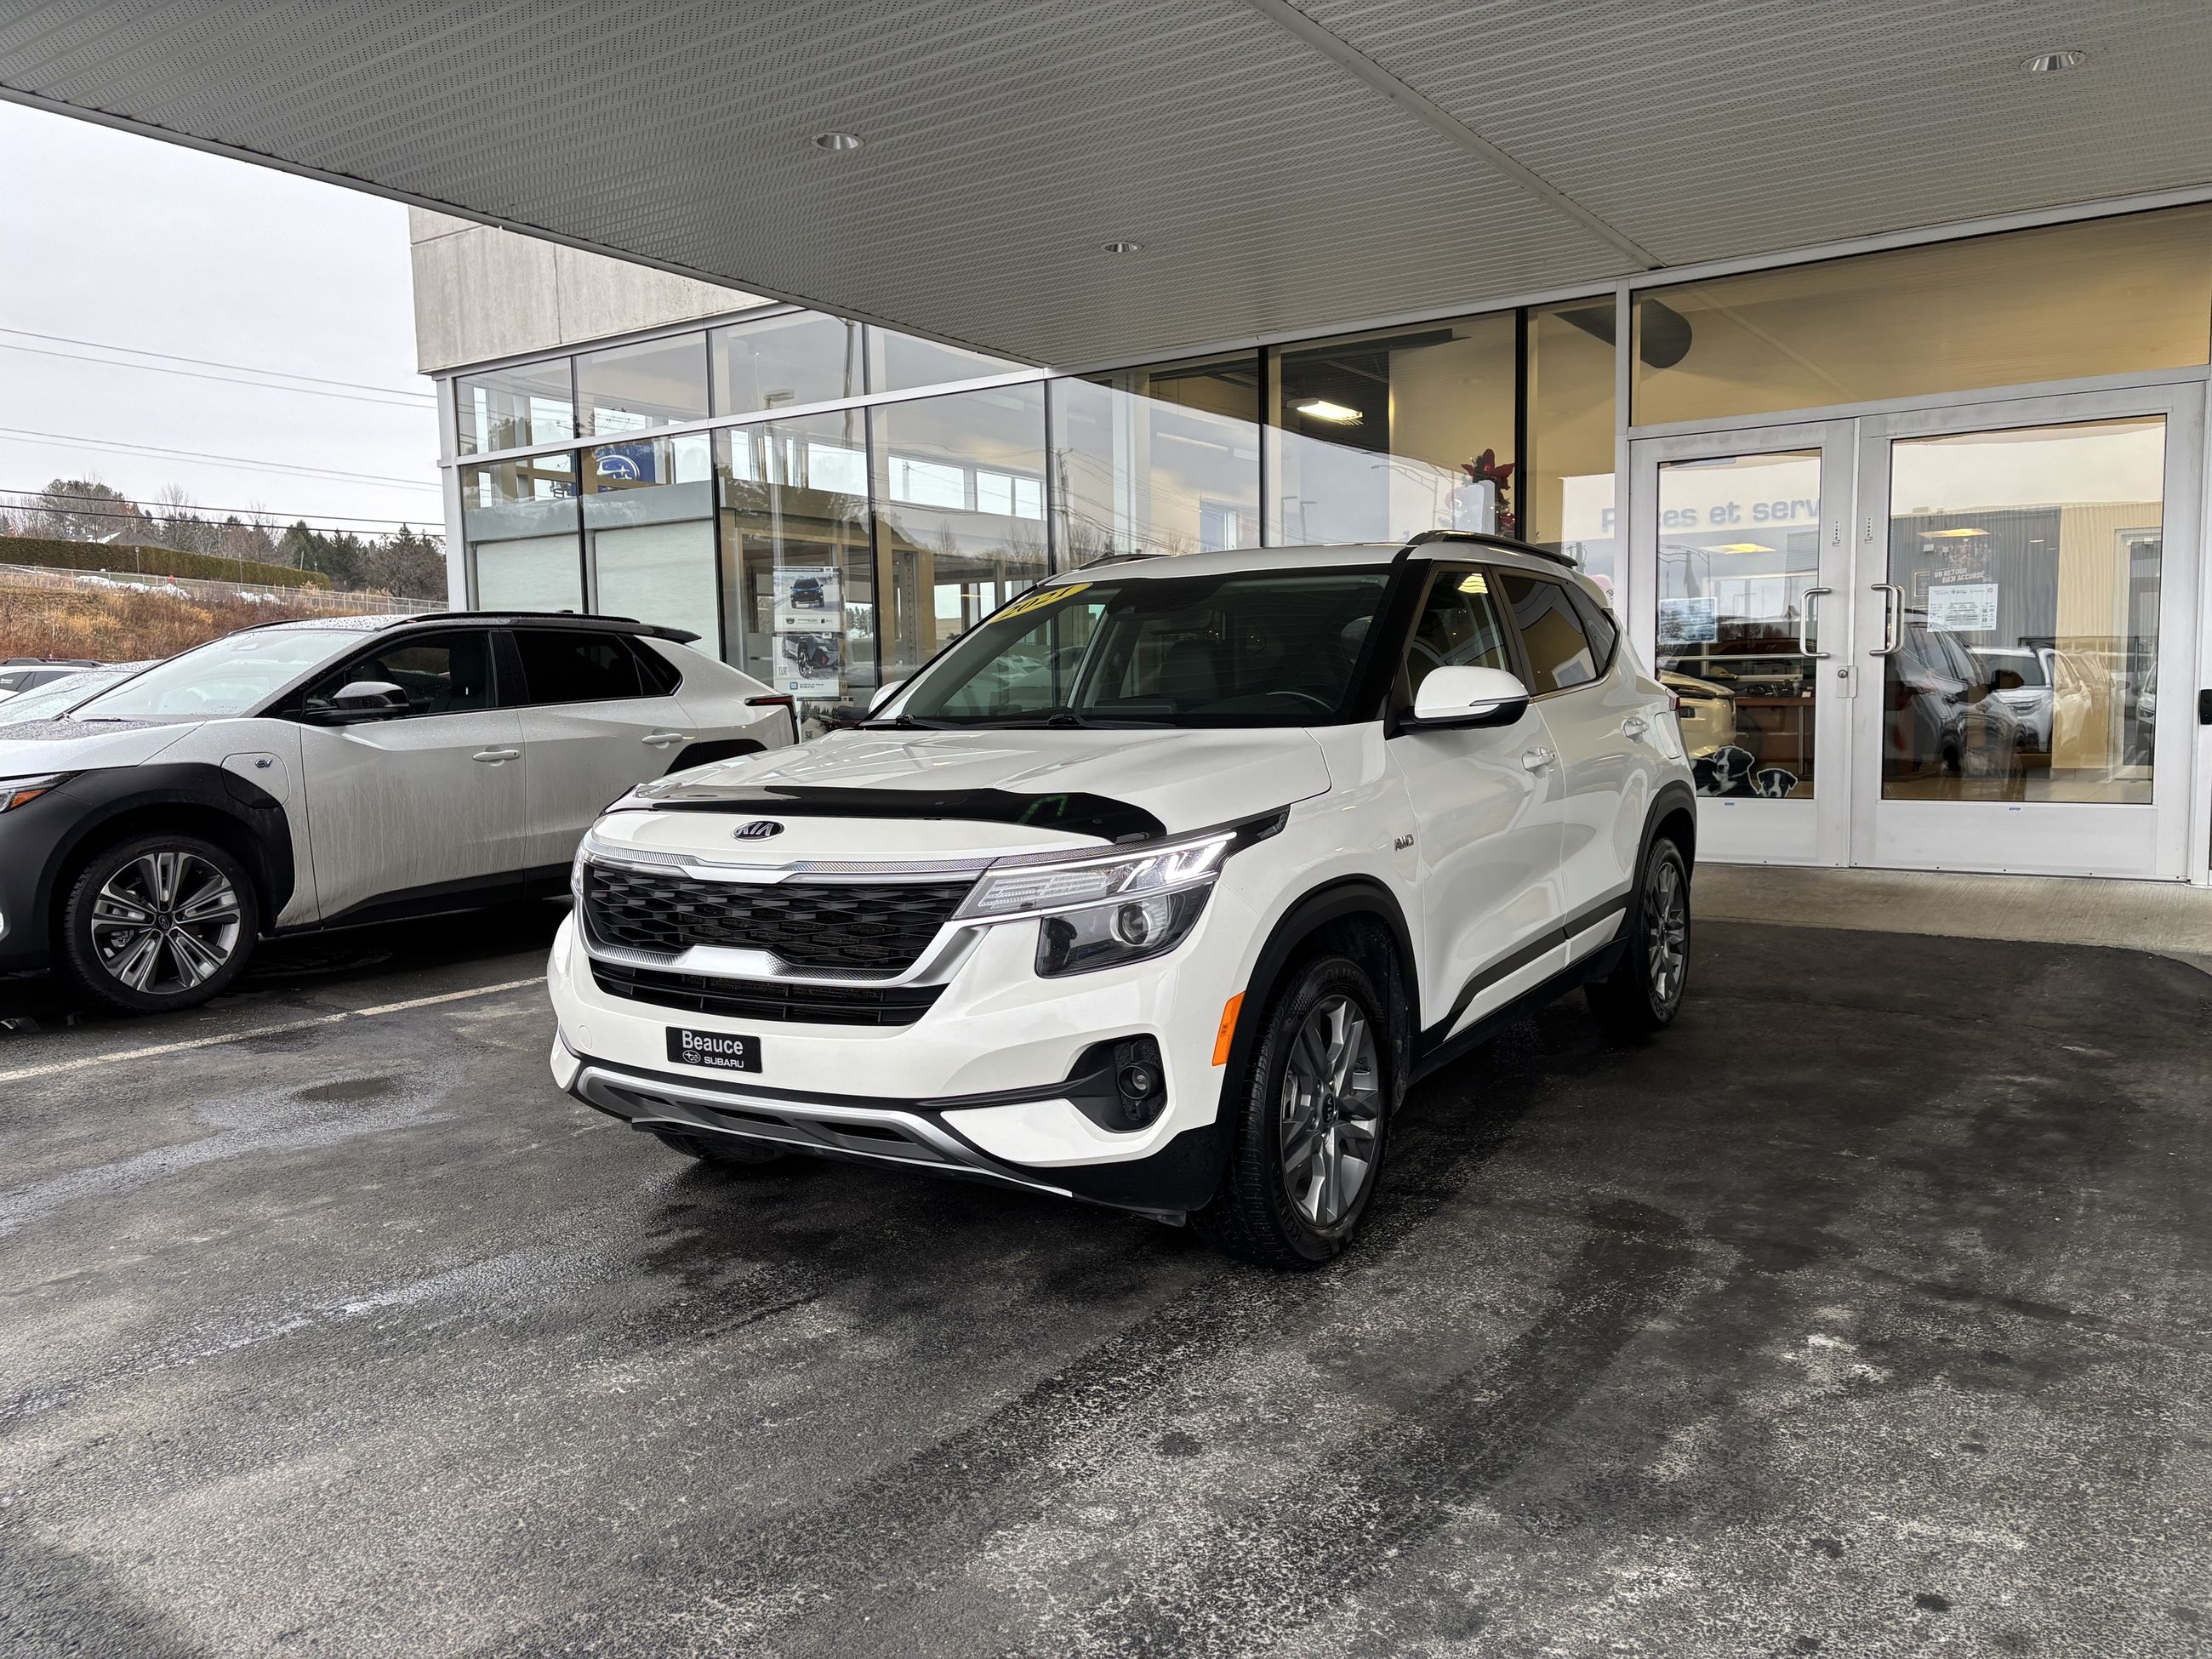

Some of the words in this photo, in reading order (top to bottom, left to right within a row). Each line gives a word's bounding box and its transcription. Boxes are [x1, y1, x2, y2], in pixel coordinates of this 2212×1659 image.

[1709, 501, 1741, 525] et
[995, 586, 1076, 621] 2021
[254, 758, 273, 768] EV
[736, 822, 775, 836] KIA
[681, 1029, 744, 1056] Beauce
[704, 1055, 744, 1069] SUBARU
